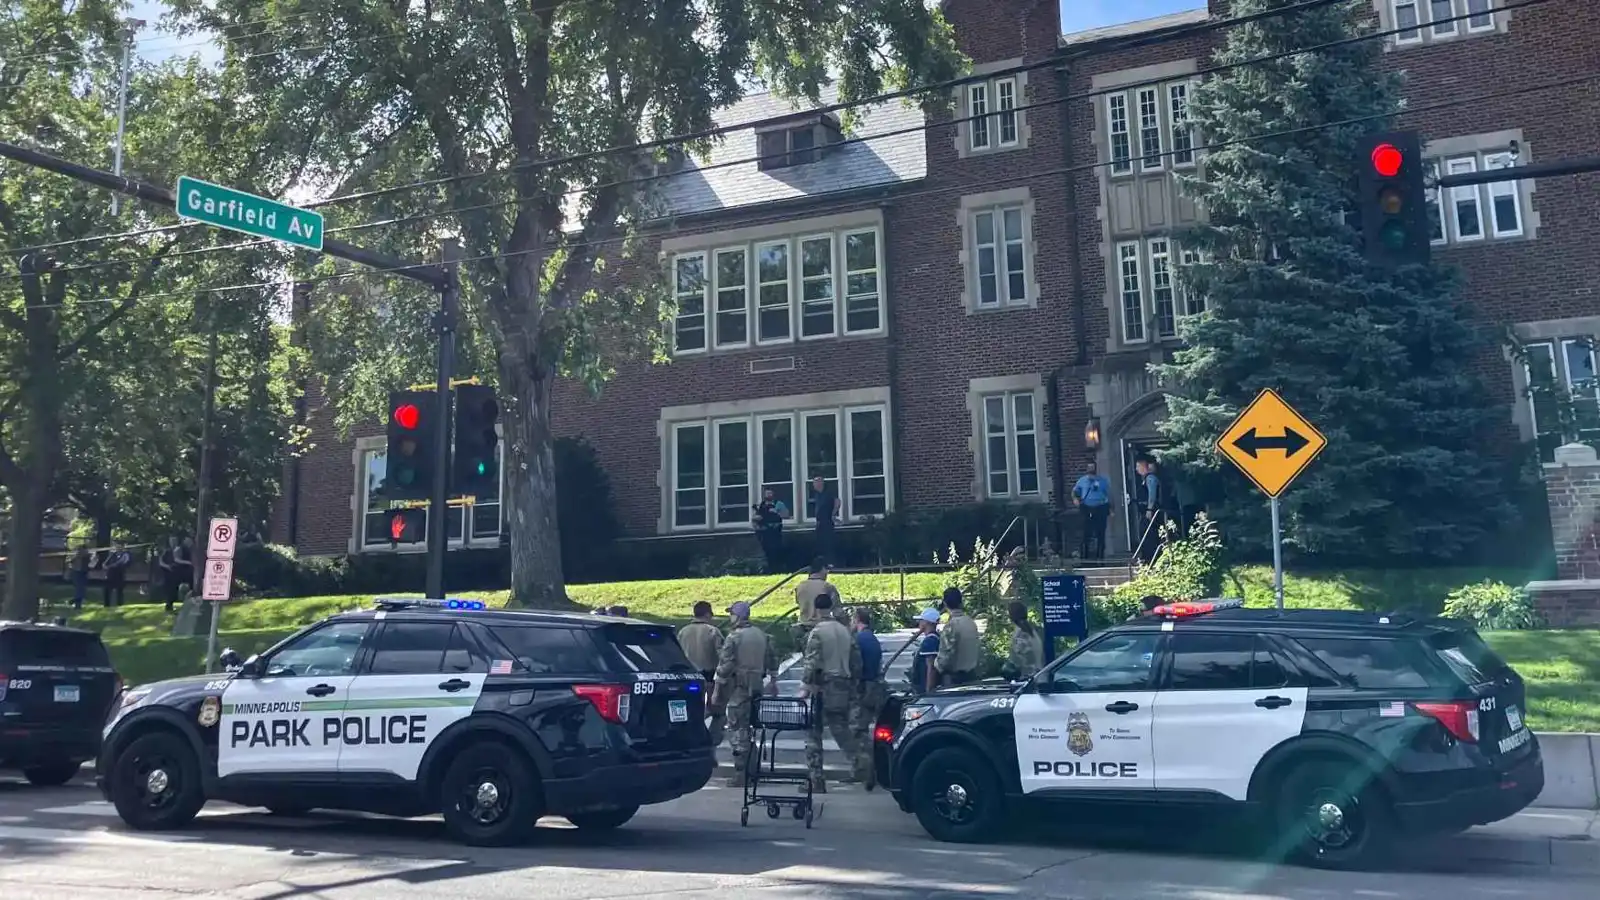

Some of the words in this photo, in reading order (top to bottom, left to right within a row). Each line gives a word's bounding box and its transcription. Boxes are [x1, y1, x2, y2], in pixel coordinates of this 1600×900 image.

[187, 189, 276, 230] Garfield
[288, 216, 314, 239] Av
[9, 679, 32, 689] 820
[204, 680, 230, 691] 850
[634, 682, 654, 695] 850
[234, 701, 301, 715] MINNEAPOLIS
[990, 698, 1015, 708] 431
[1479, 696, 1496, 712] 431
[231, 718, 312, 749] PARK
[323, 714, 427, 746] POLICE
[1033, 761, 1138, 778] POLICE
